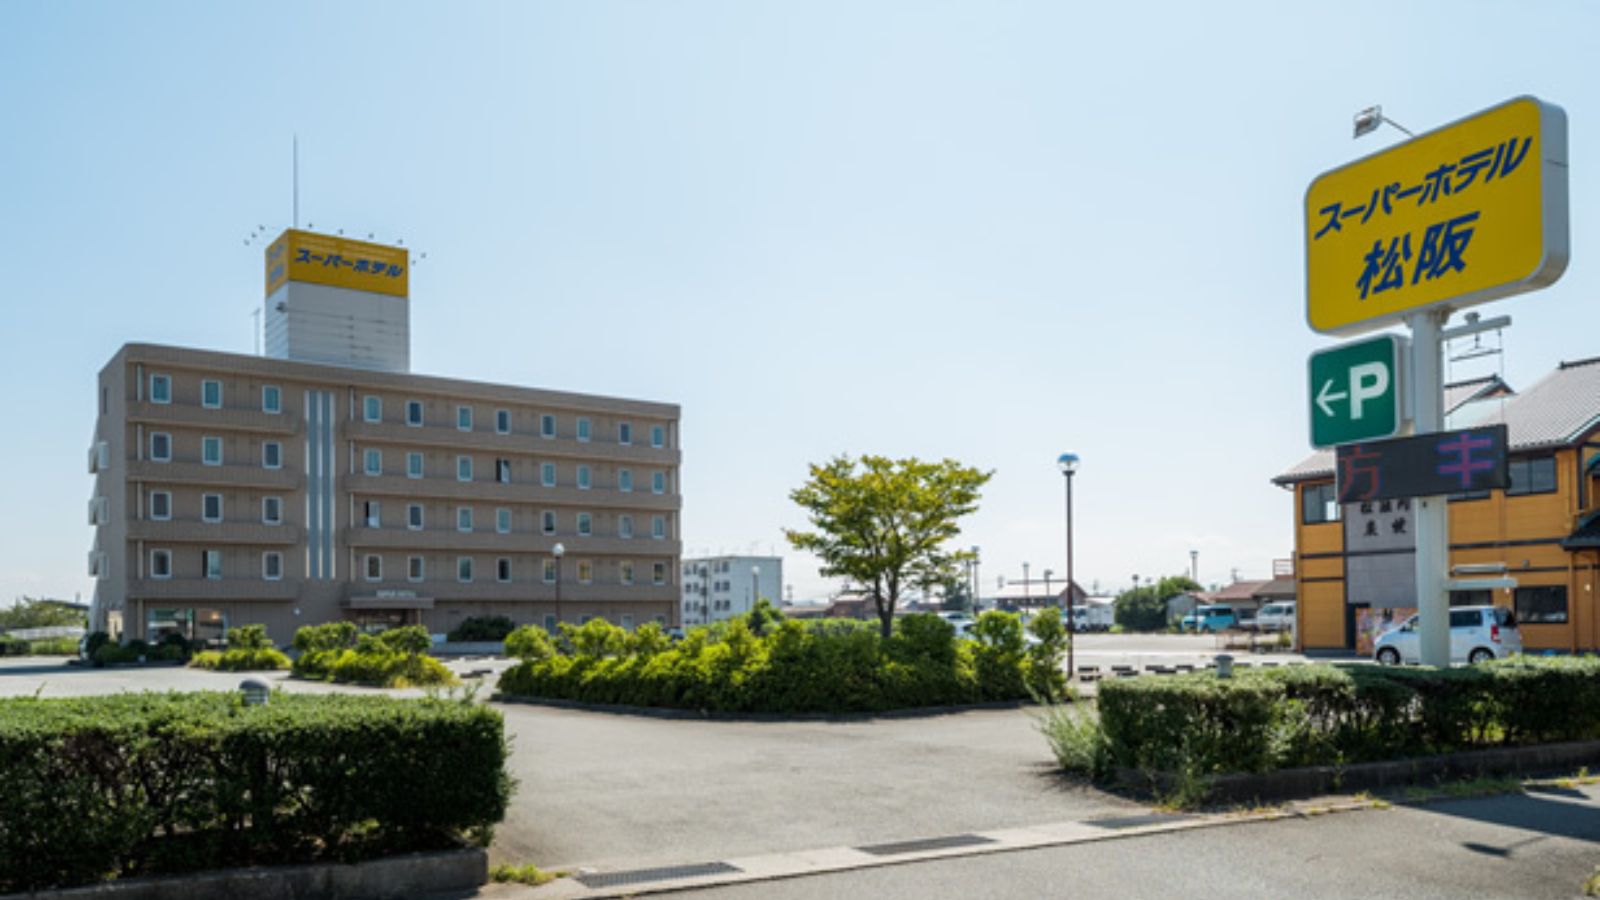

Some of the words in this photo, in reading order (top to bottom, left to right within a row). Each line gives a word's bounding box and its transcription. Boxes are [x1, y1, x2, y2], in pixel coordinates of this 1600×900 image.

[1314, 136, 1533, 241] スーパーホテル
[294, 247, 403, 277] スーパーホテル
[1356, 211, 1481, 300] 松阪
[1349, 361, 1389, 420] P
